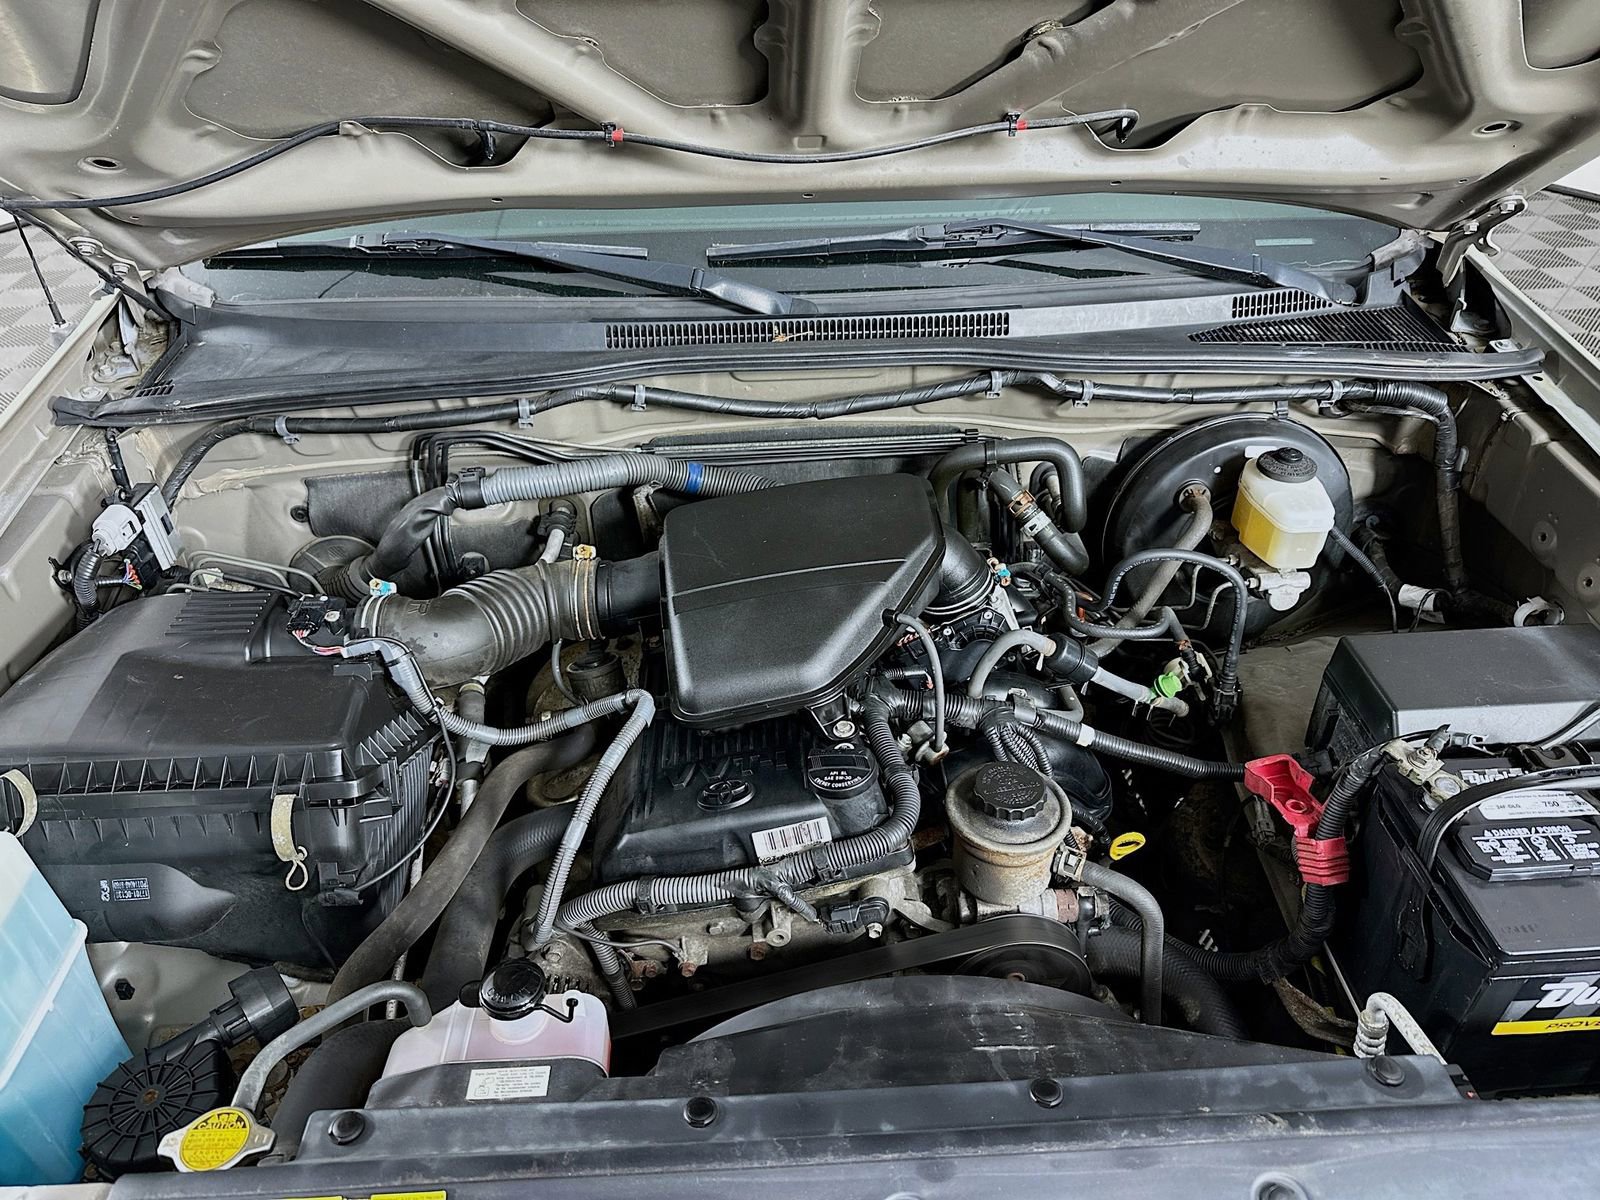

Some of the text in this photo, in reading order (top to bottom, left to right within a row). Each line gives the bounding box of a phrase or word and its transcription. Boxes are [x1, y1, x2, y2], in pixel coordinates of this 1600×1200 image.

[1491, 827, 1531, 837] DANGER
[1535, 981, 1600, 1008] Du
[198, 1121, 244, 1130] CAUTION
